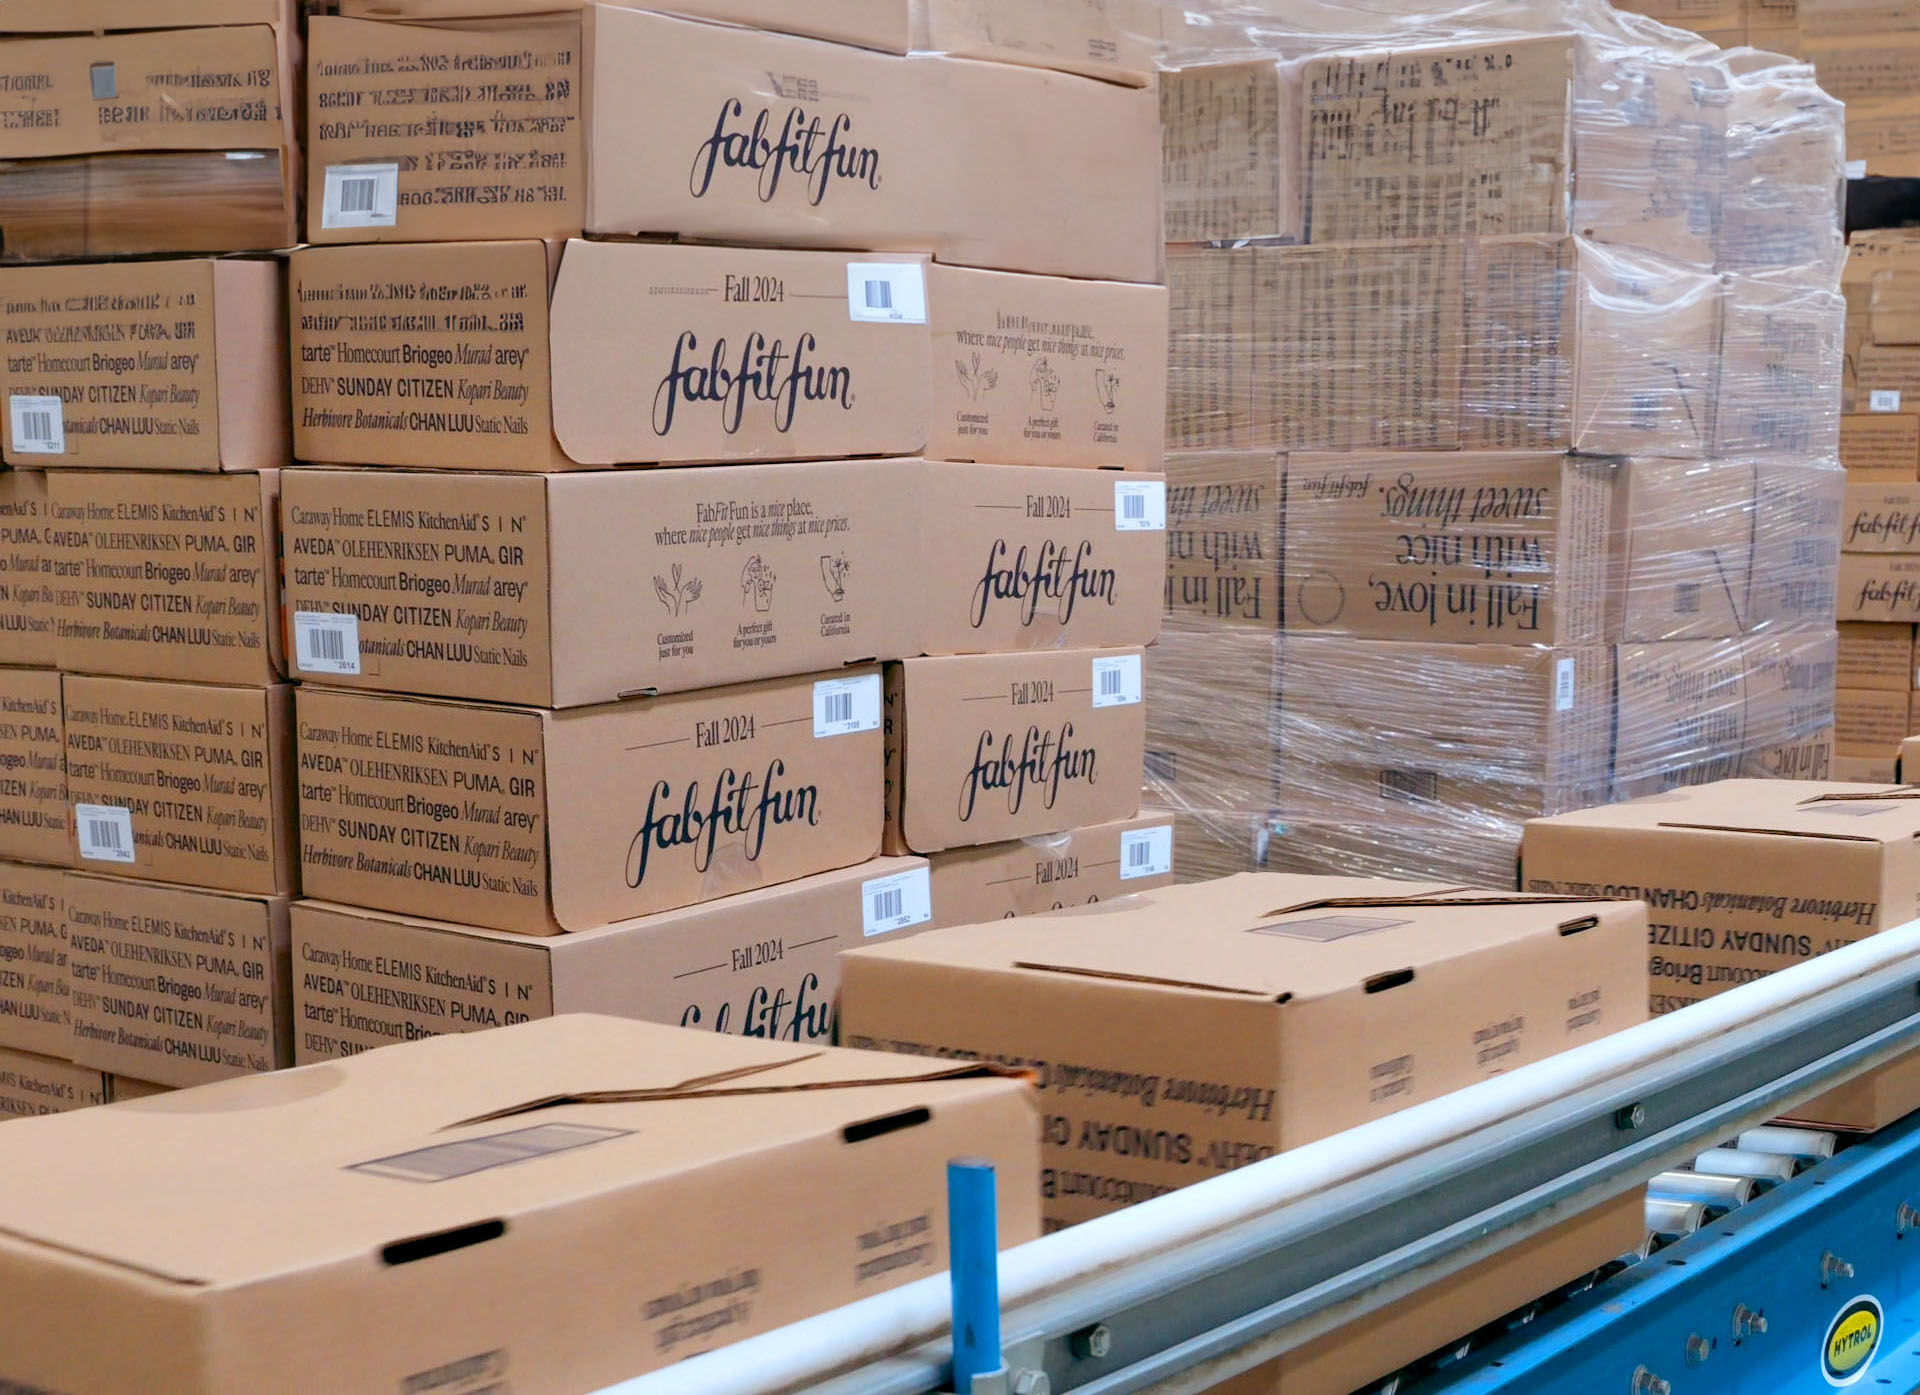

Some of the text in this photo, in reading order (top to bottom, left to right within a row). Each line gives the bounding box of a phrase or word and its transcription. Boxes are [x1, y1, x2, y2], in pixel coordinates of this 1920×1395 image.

[724, 275, 750, 302] Fall
[753, 275, 784, 302] 2024
[93, 354, 134, 375] Briogeo
[337, 343, 401, 364] Homecourt
[403, 345, 452, 369] Briogeo
[88, 386, 136, 402] CITIZEN
[337, 378, 528, 406] SUNDAY CITIZEN Kopari Beauty
[100, 416, 130, 434] CHAN
[133, 417, 153, 435] LUU
[303, 408, 528, 434] Herbivore Botanicals CHAN LUU Static Nails
[117, 504, 158, 521] ELEMIS
[697, 501, 749, 524] FabFitFun
[751, 502, 759, 519] is
[761, 505, 766, 519] a
[768, 500, 785, 518] nice
[1027, 495, 1070, 518] Fall 2024
[1379, 473, 1548, 528] sweet things.
[292, 505, 414, 531] Caraway Home ELEMIS
[655, 515, 850, 547] where nice people get nice things at nice prices.
[233, 536, 256, 553] GIR
[342, 539, 523, 565] OLEHENRIKSEN GIR
[1204, 531, 1263, 572] with
[1396, 523, 1542, 578] with nice
[145, 562, 190, 584] Briogeo
[332, 567, 490, 596] Homecourt Briogeo Murad
[87, 593, 136, 610] SUNDAY
[141, 594, 191, 613] CITIZEN
[1182, 575, 1262, 619] Fall in
[1369, 571, 1539, 631] Fall in love,
[332, 602, 528, 639] SUNDAY CITIZEN Kopari Beauty
[821, 625, 850, 637] California
[152, 626, 185, 644] CHAN
[188, 629, 210, 645] LUU
[658, 630, 693, 645] Customized
[407, 640, 528, 667] CHAN LUU Static Nails
[659, 646, 693, 660] just for you
[1012, 680, 1053, 705] Fall 2024
[129, 711, 168, 730] ELEMIS
[696, 714, 755, 748] Fall 2024
[300, 721, 423, 752] Caraway Home ELEMIS
[241, 750, 263, 768] GIR
[157, 771, 200, 793] Briogeo
[350, 759, 534, 797] OLEHENRIKSEN GIR
[154, 801, 202, 822] CITIZEN
[339, 785, 500, 825] Homecourt Briogeo Murad
[166, 832, 222, 856] CHAN LUU
[339, 819, 538, 869] SUNDAY CITIZEN Kopari Beauty
[303, 844, 537, 897] Herbivore Botanicals CHAN LUU Static Nails
[1036, 857, 1078, 885] Fall 2024
[131, 916, 170, 937] ELEMIS
[1648, 924, 1811, 956] SUNDAY CITIZE
[302, 943, 421, 981] Caraway Home ELEMIS
[732, 937, 783, 972] Fall 2024
[242, 961, 263, 981] GIR
[157, 976, 200, 1000] Briogeo
[351, 982, 445, 1016] OLEHENRIKSEN
[102, 997, 202, 1031] SUNDAY CITIZEN
[340, 1007, 403, 1039] Homecourt
[164, 1038, 221, 1064] CHAN LUU
[1080, 1118, 1192, 1165] SUNDAY
[1834, 1324, 1871, 1357] HYTROL
